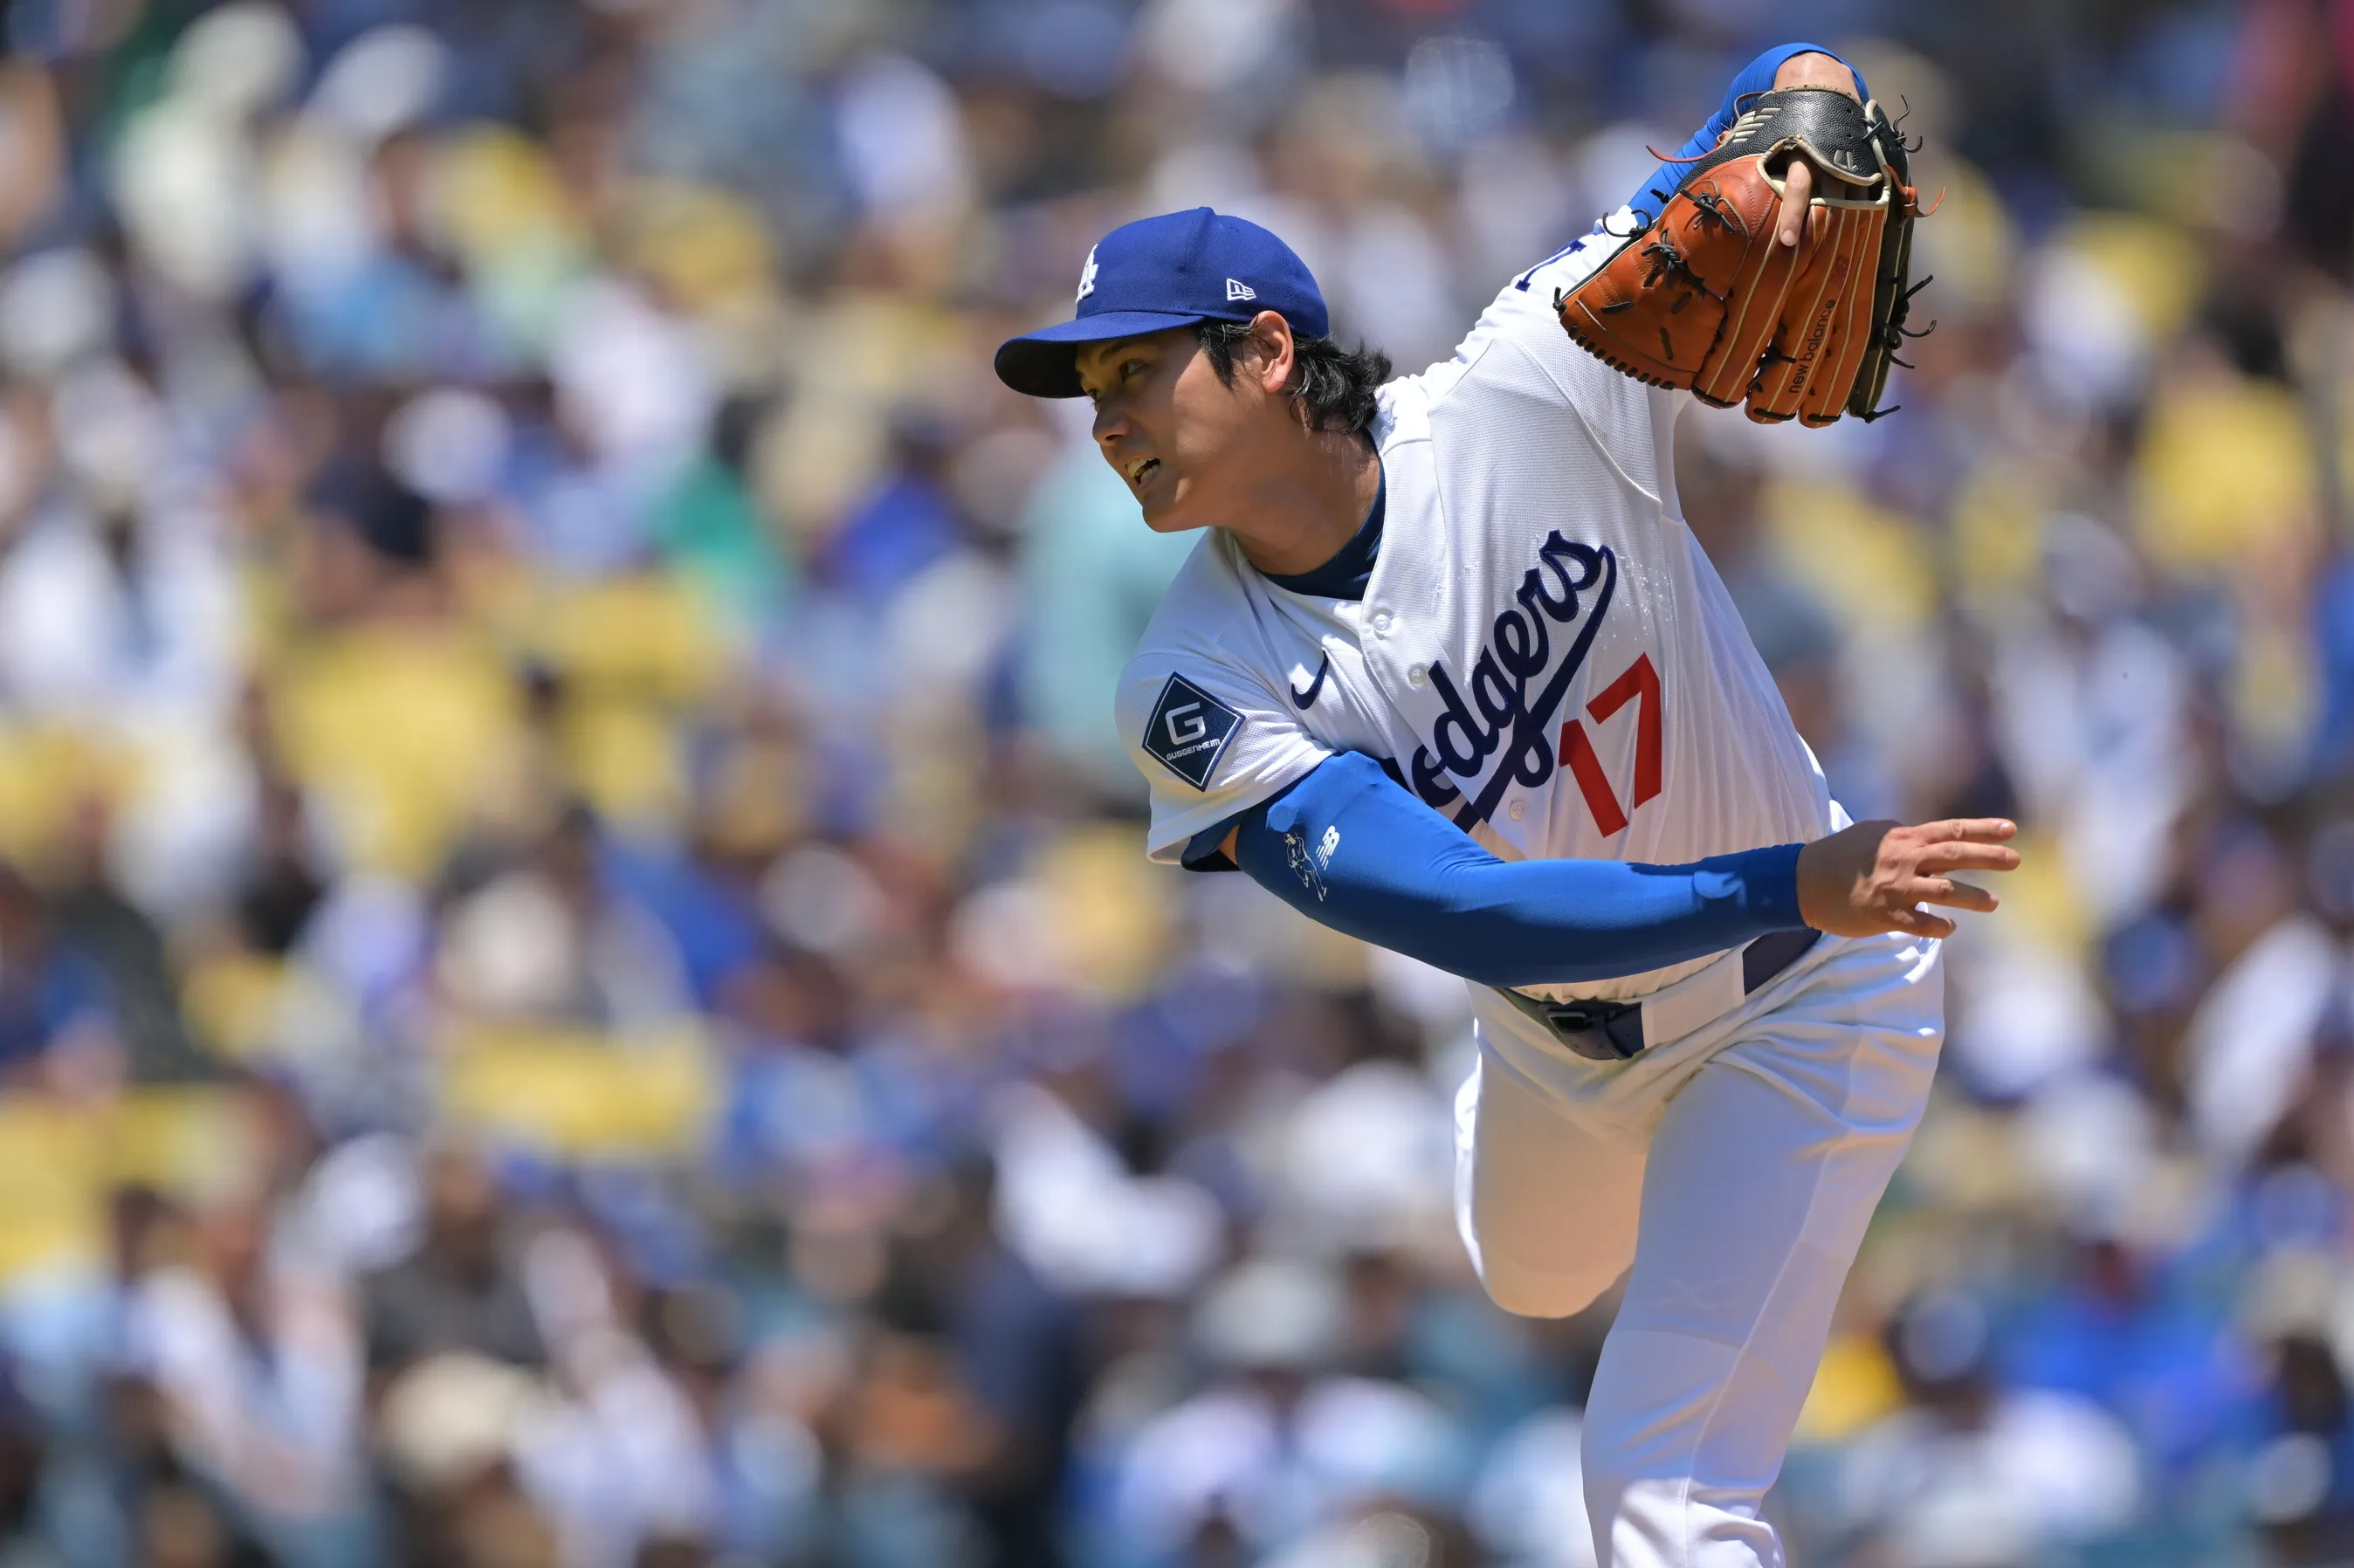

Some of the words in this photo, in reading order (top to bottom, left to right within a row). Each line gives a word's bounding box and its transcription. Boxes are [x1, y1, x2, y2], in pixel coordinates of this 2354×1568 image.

[1788, 365, 1809, 394] new
[1799, 299, 1836, 362] balance
[1165, 701, 1206, 746] G
[1411, 528, 1617, 836] odgers
[1166, 738, 1221, 761] GUGGENHEIM
[1558, 652, 1662, 838] 17
